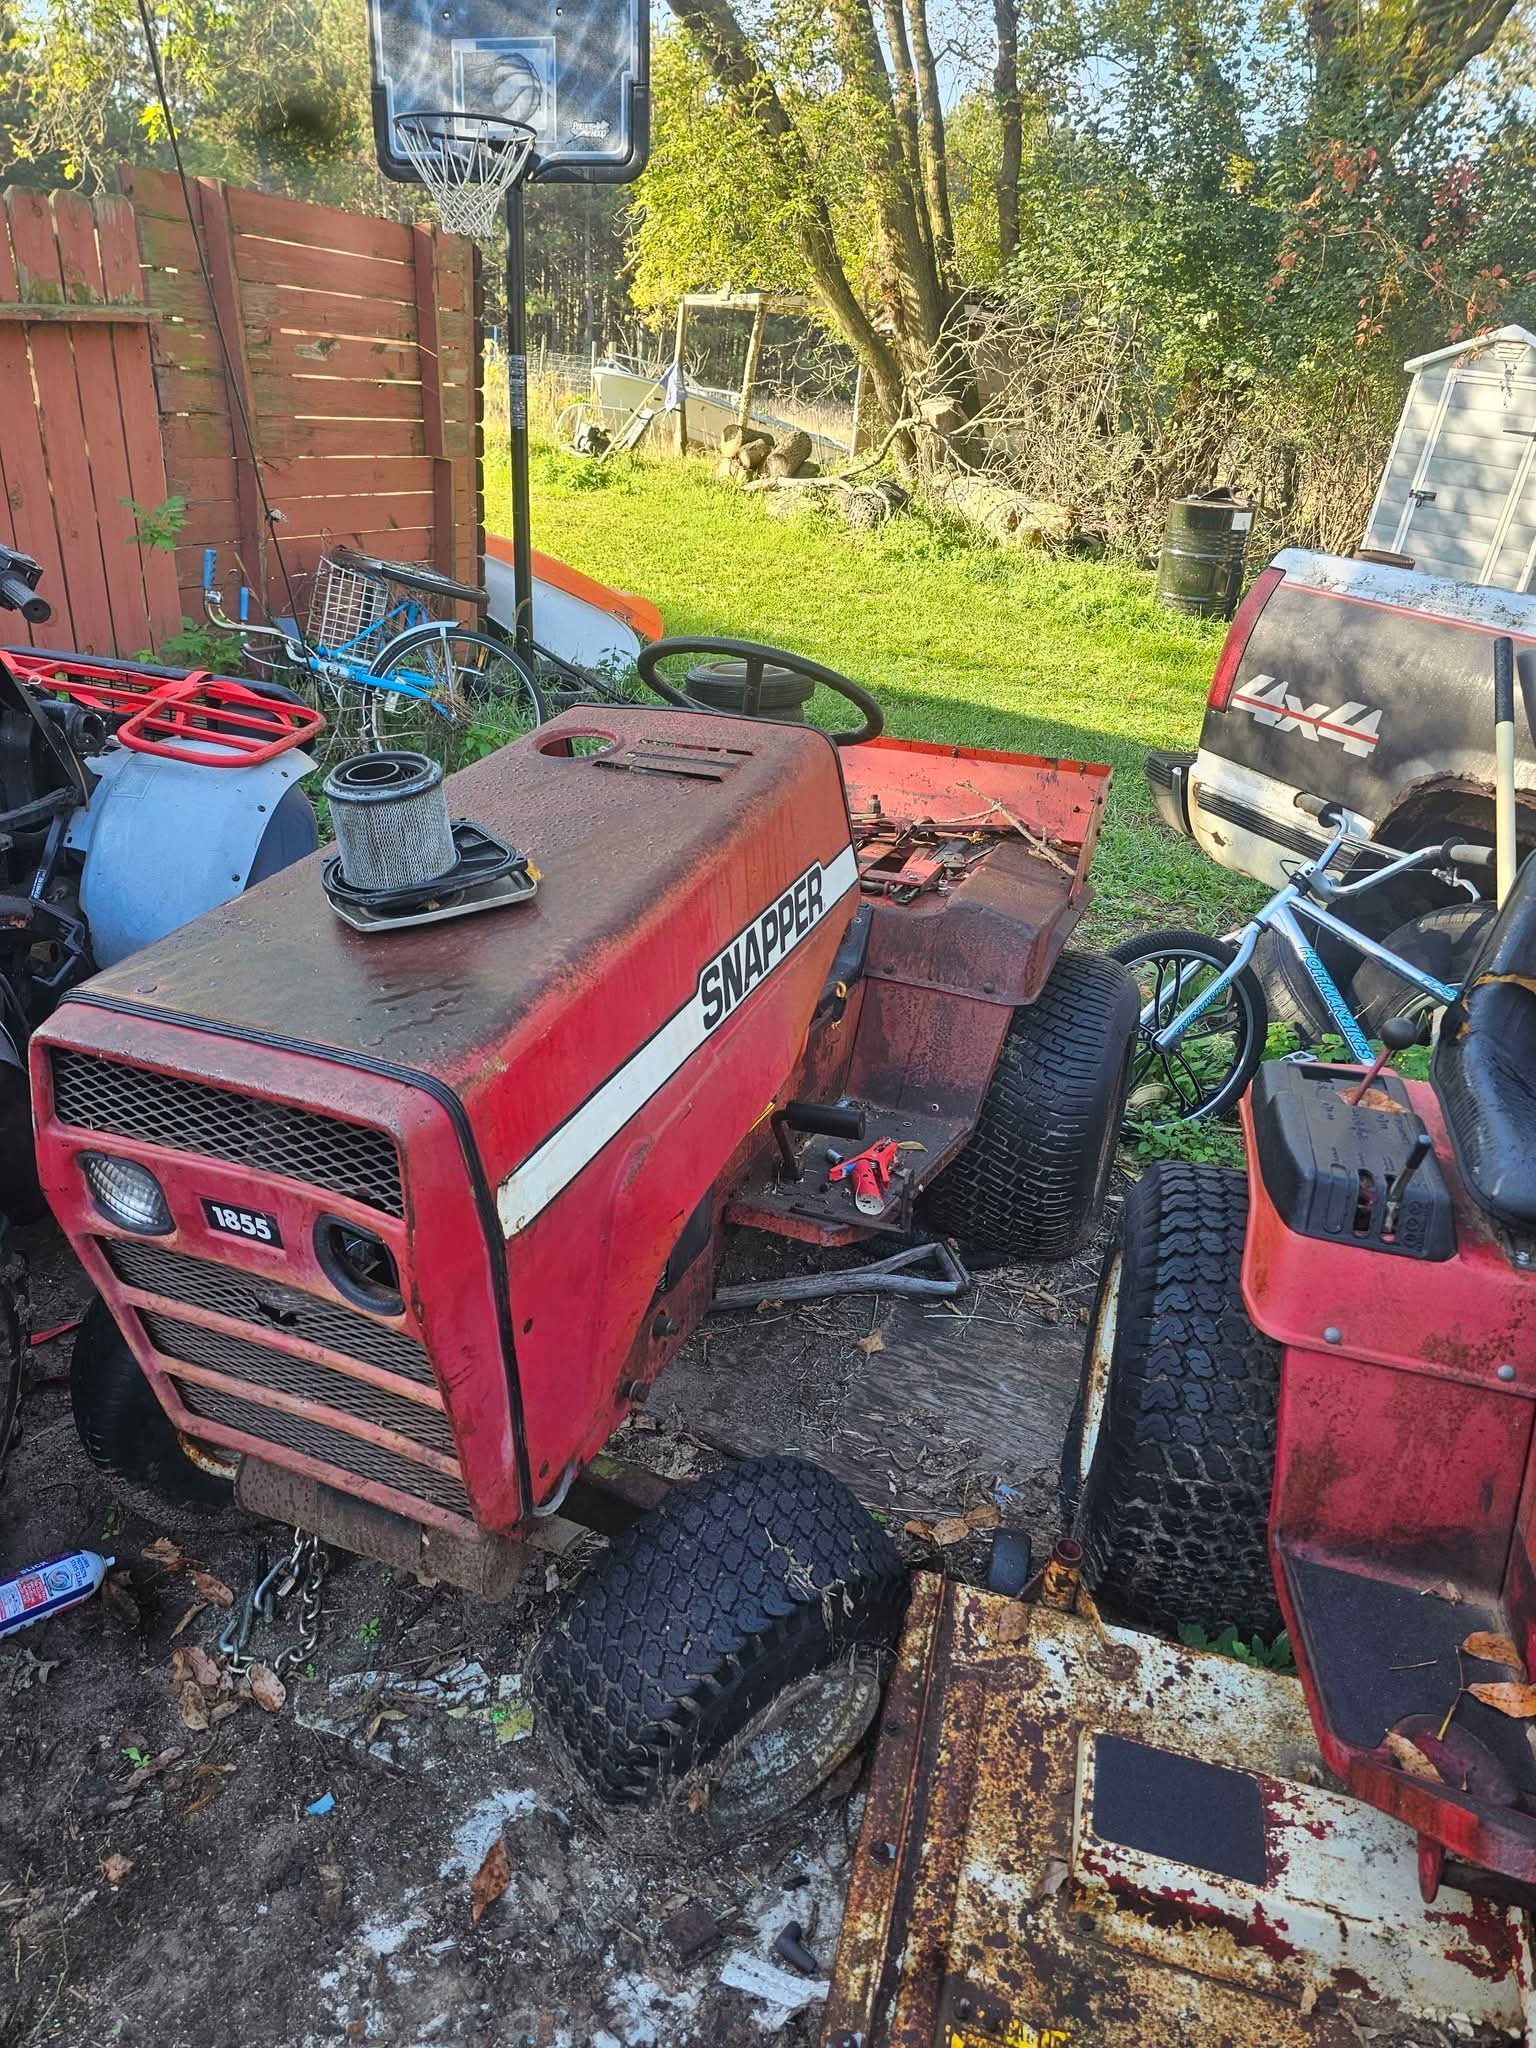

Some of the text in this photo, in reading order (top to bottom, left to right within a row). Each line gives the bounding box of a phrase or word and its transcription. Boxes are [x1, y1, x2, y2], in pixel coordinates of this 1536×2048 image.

[1231, 674, 1383, 758] 4x4
[701, 866, 823, 1031] SNAPPER
[211, 1206, 271, 1240] 1855
